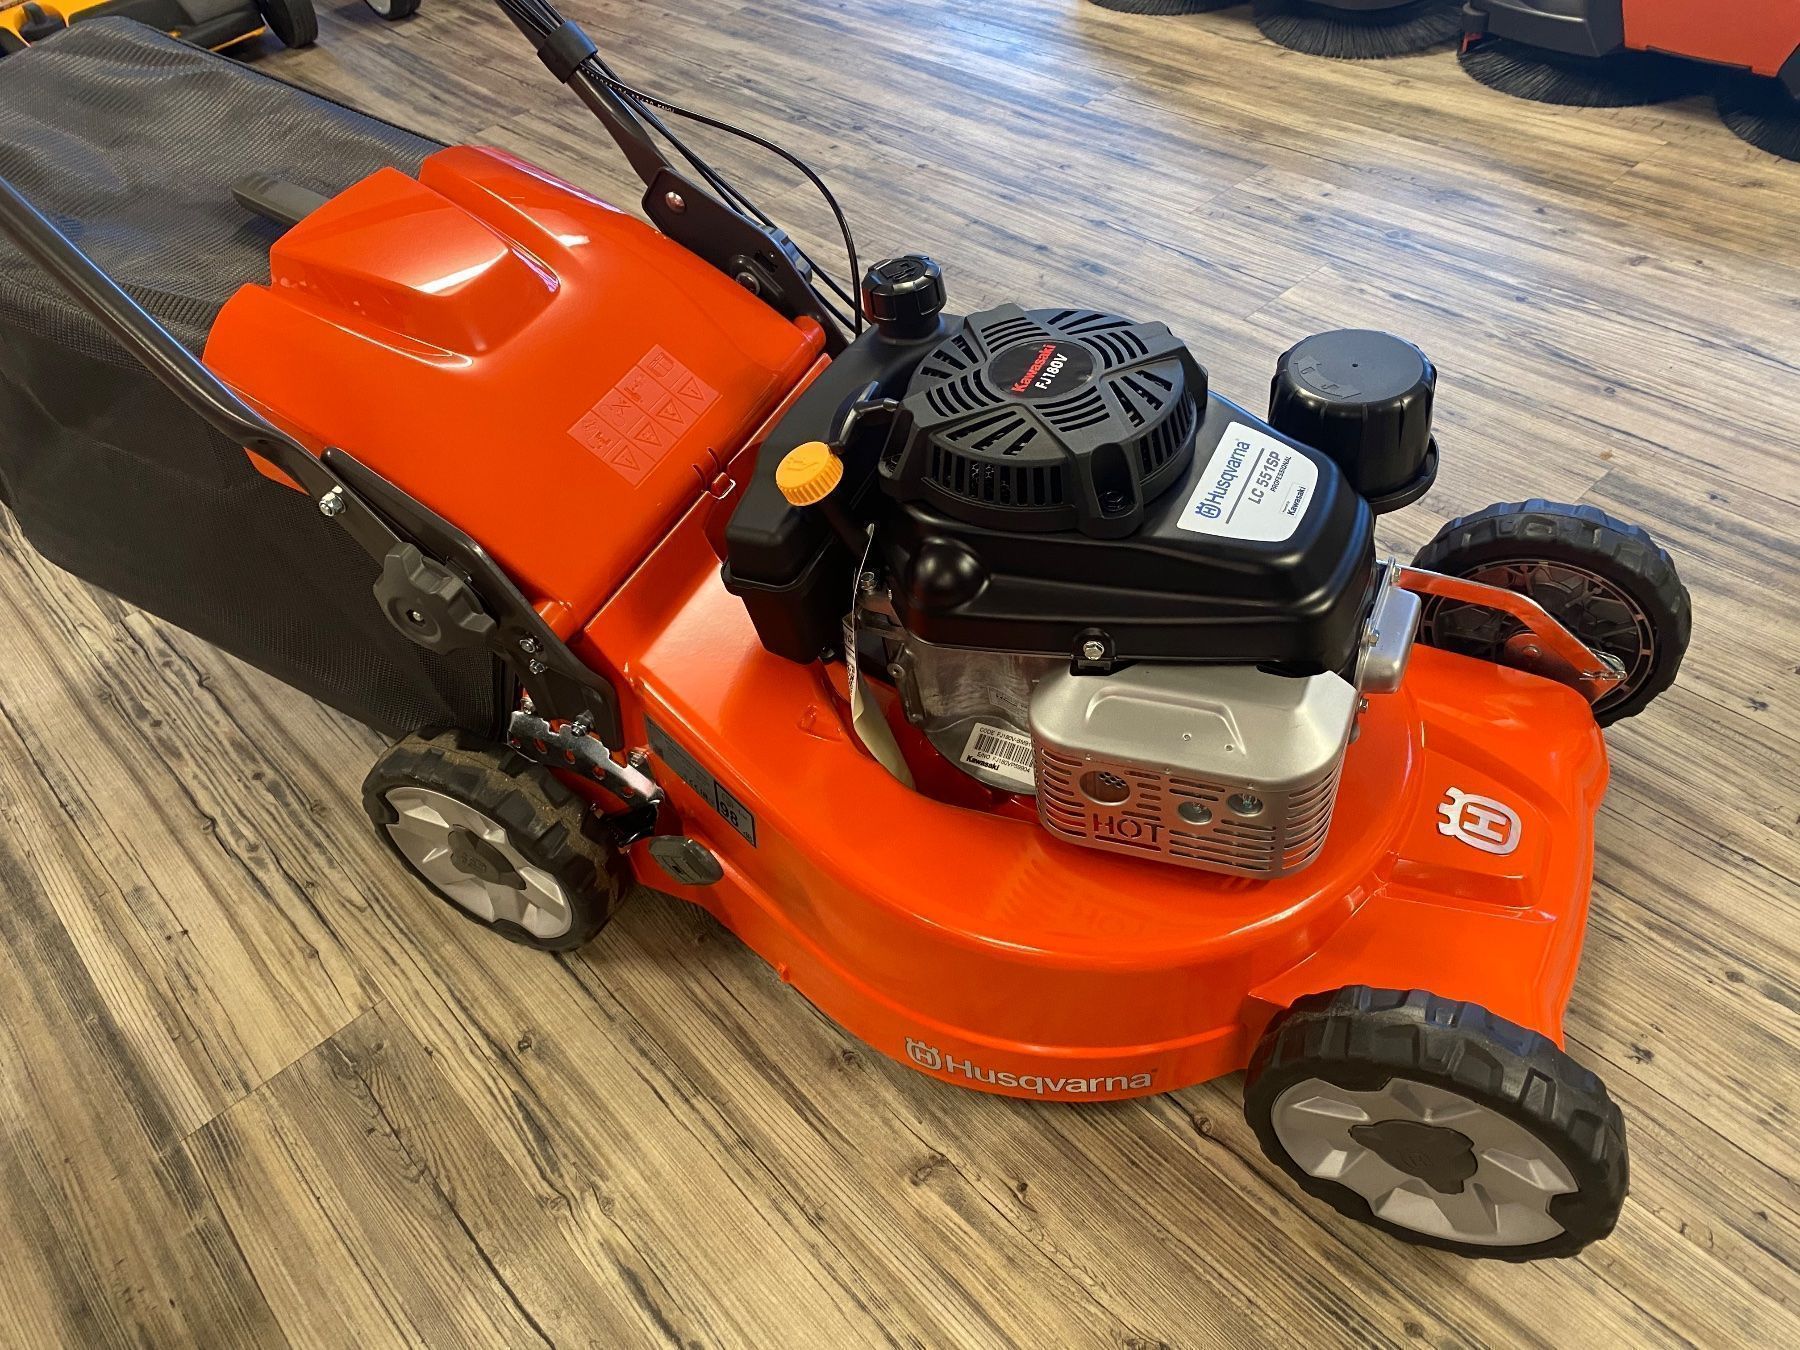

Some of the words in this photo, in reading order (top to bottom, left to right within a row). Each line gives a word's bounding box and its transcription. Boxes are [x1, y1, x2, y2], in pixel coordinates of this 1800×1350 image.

[1010, 344, 1056, 392] Kawasaki
[1035, 353, 1068, 389] FJ180V
[1204, 441, 1251, 506] Husqvarna
[1247, 488, 1265, 505] LC
[1256, 451, 1281, 488] 551SP
[1270, 456, 1292, 492] PROFESSIONAL
[1287, 486, 1307, 516] Kawasaki
[966, 755, 1000, 771] Kawasaki
[720, 802, 739, 827] 98
[1093, 813, 1165, 843] HOT
[946, 1054, 1152, 1095] Husqvarna
